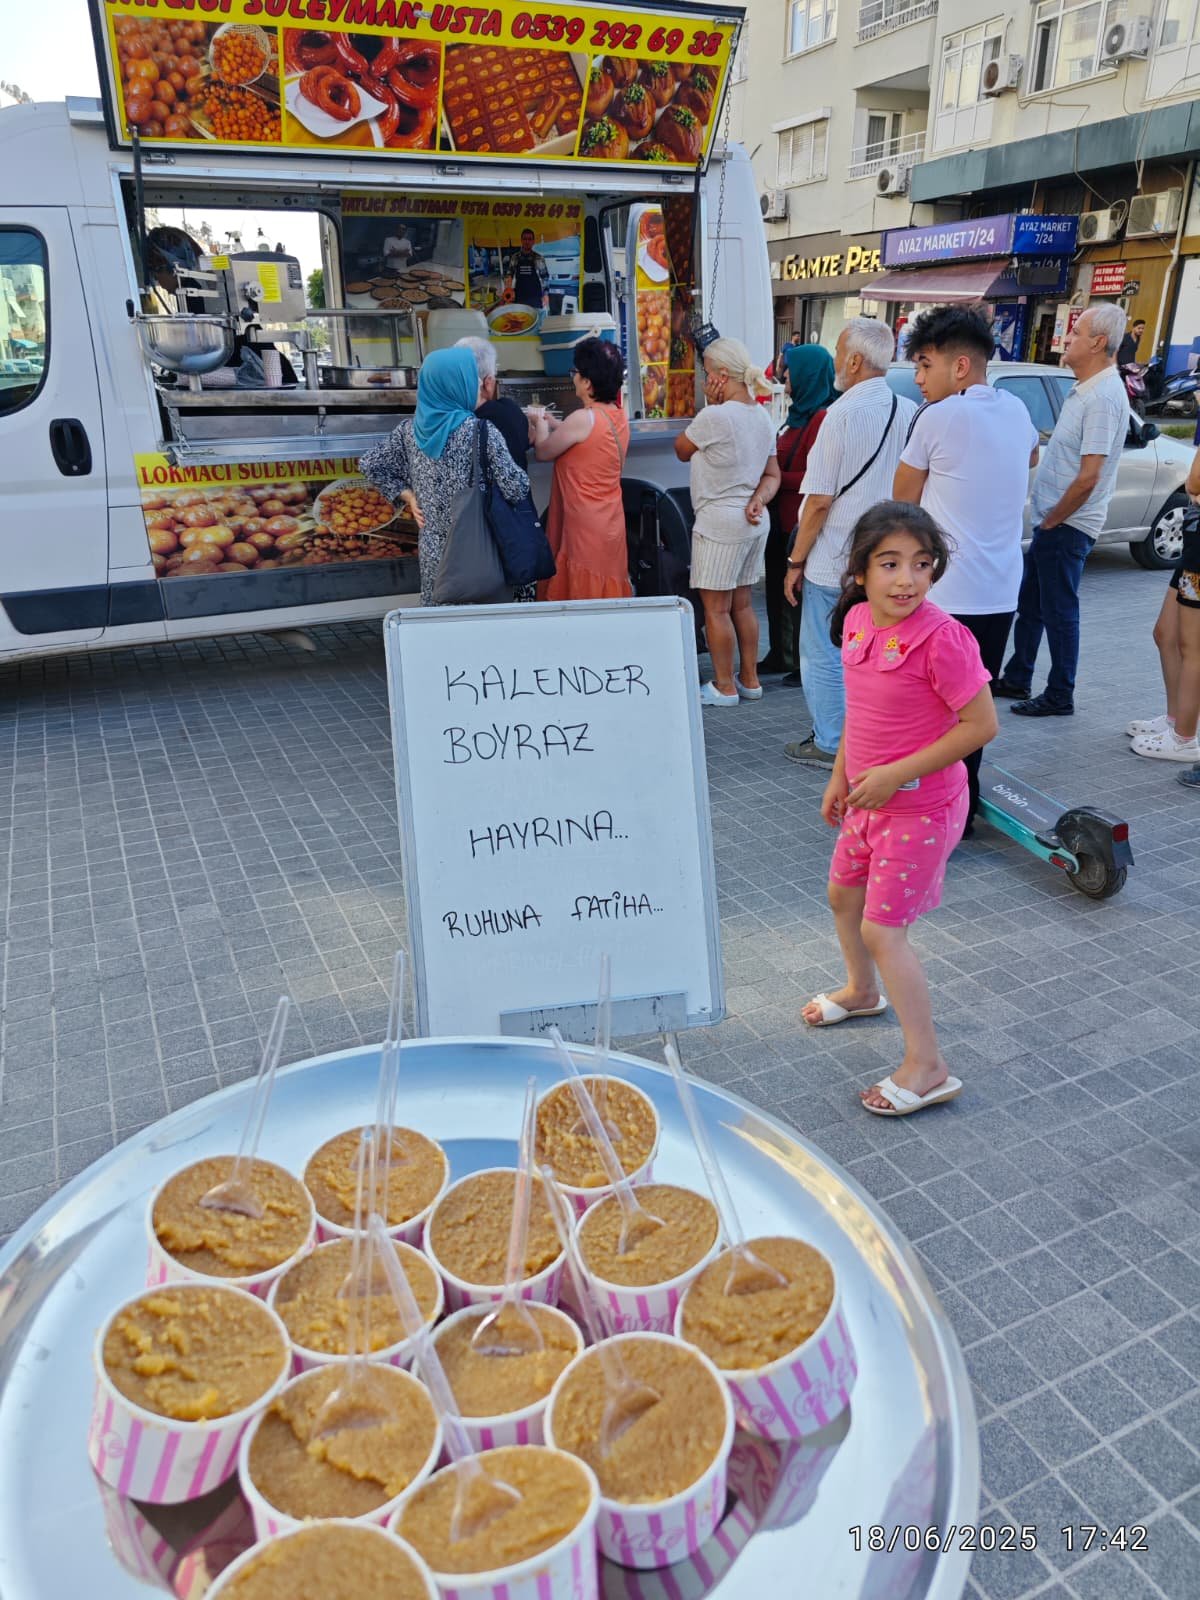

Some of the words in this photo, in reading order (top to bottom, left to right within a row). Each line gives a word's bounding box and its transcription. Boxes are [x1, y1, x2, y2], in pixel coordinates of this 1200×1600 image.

[430, 3, 502, 36] USTA
[511, 12, 585, 44] 0539
[590, 21, 642, 50] 292
[648, 28, 684, 54] 69
[688, 31, 723, 56] 38
[461, 201, 489, 216] USTA
[1019, 222, 1038, 232] AYAZ
[1040, 222, 1072, 232] MARKET
[1034, 233, 1054, 244] 7/24
[898, 236, 921, 255] AYAZ
[923, 231, 967, 250] MARKET
[968, 227, 995, 247] 7/24
[783, 254, 841, 281] GAMZE
[140, 463, 233, 486] LOKMACI
[444, 664, 650, 705] KALENDER
[443, 722, 595, 764] BOYRAZ
[991, 783, 1029, 808] binbin
[469, 810, 629, 859] HAYRINA...
[442, 904, 543, 939] RUHUNA
